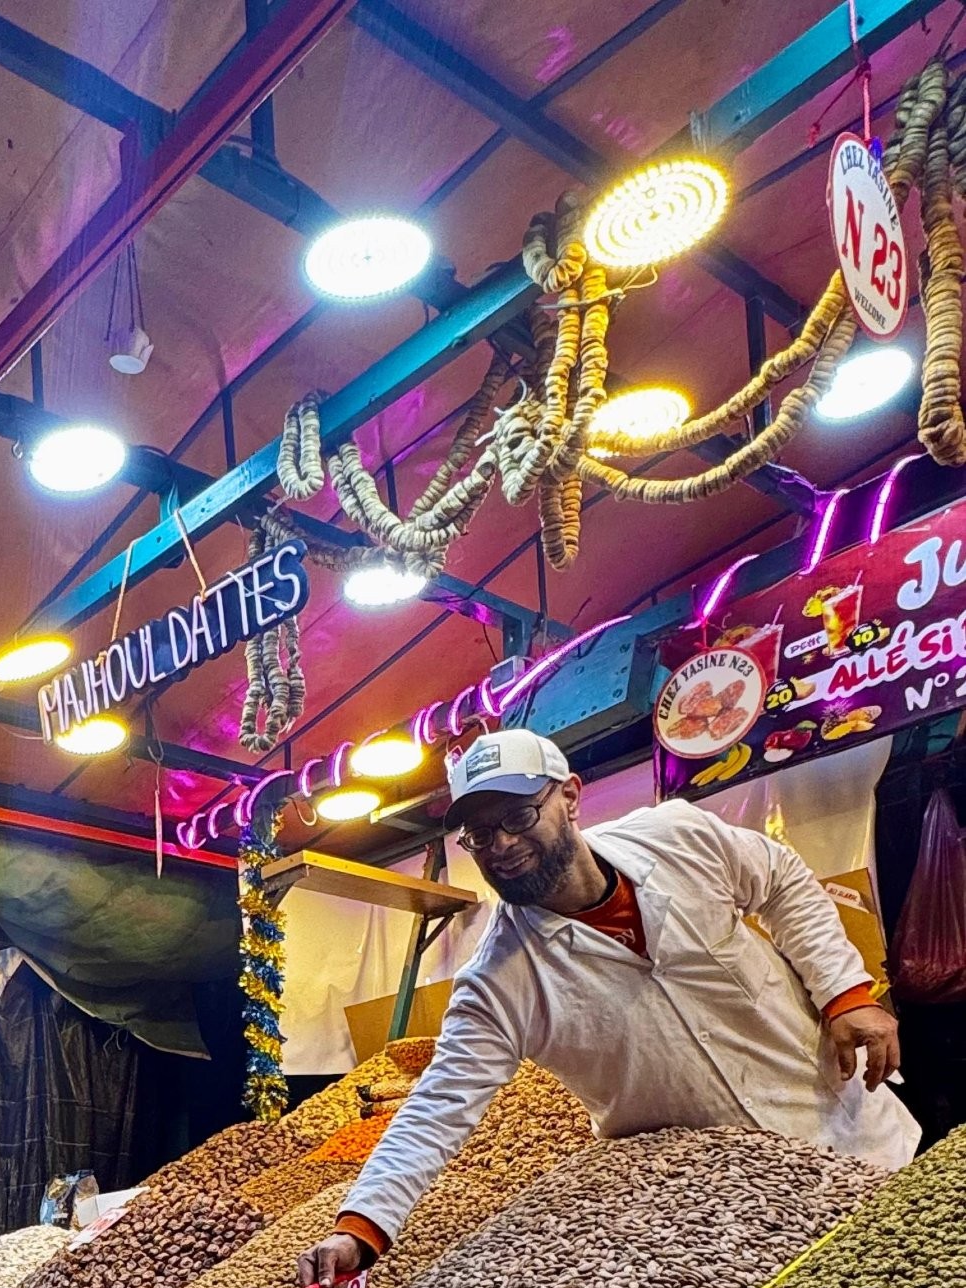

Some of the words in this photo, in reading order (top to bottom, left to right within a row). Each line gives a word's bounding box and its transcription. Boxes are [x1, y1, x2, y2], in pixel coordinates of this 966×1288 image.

[840, 145, 864, 175] CHEZ
[868, 155, 899, 231] YASINE
[842, 186, 865, 272] N
[871, 223, 902, 310] 23
[854, 287, 886, 330] WELCOME
[38, 625, 166, 743] MAJHOUL
[168, 545, 300, 670] DATTES
[827, 627, 909, 694] ALLÉ
[852, 630, 875, 646] 10
[658, 678, 682, 720] CHEZ
[681, 654, 727, 682] YASINE
[728, 655, 754, 677] N23
[766, 688, 793, 709] 20
